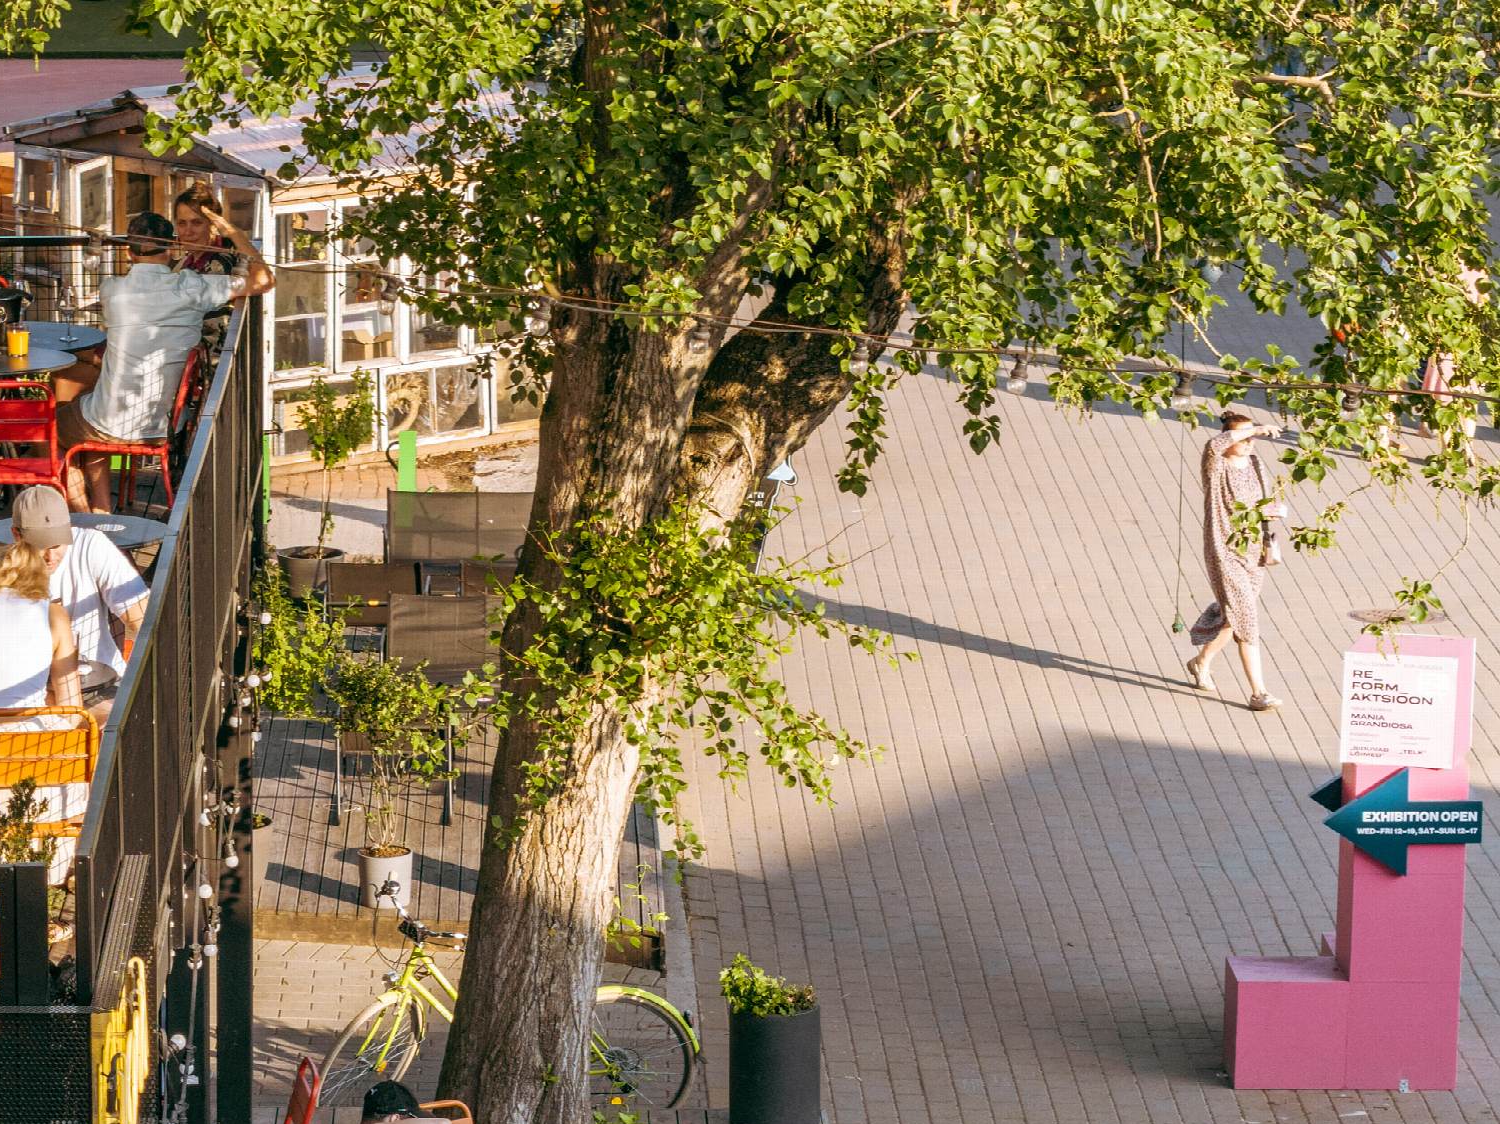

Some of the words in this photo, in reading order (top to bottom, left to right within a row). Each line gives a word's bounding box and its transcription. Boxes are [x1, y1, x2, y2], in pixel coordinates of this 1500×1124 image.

[1350, 713, 1385, 721] MANIA
[1350, 720, 1413, 730] GRANDIOSA
[1362, 811, 1439, 822] EXHIBITION
[1440, 811, 1478, 822] OPEN
